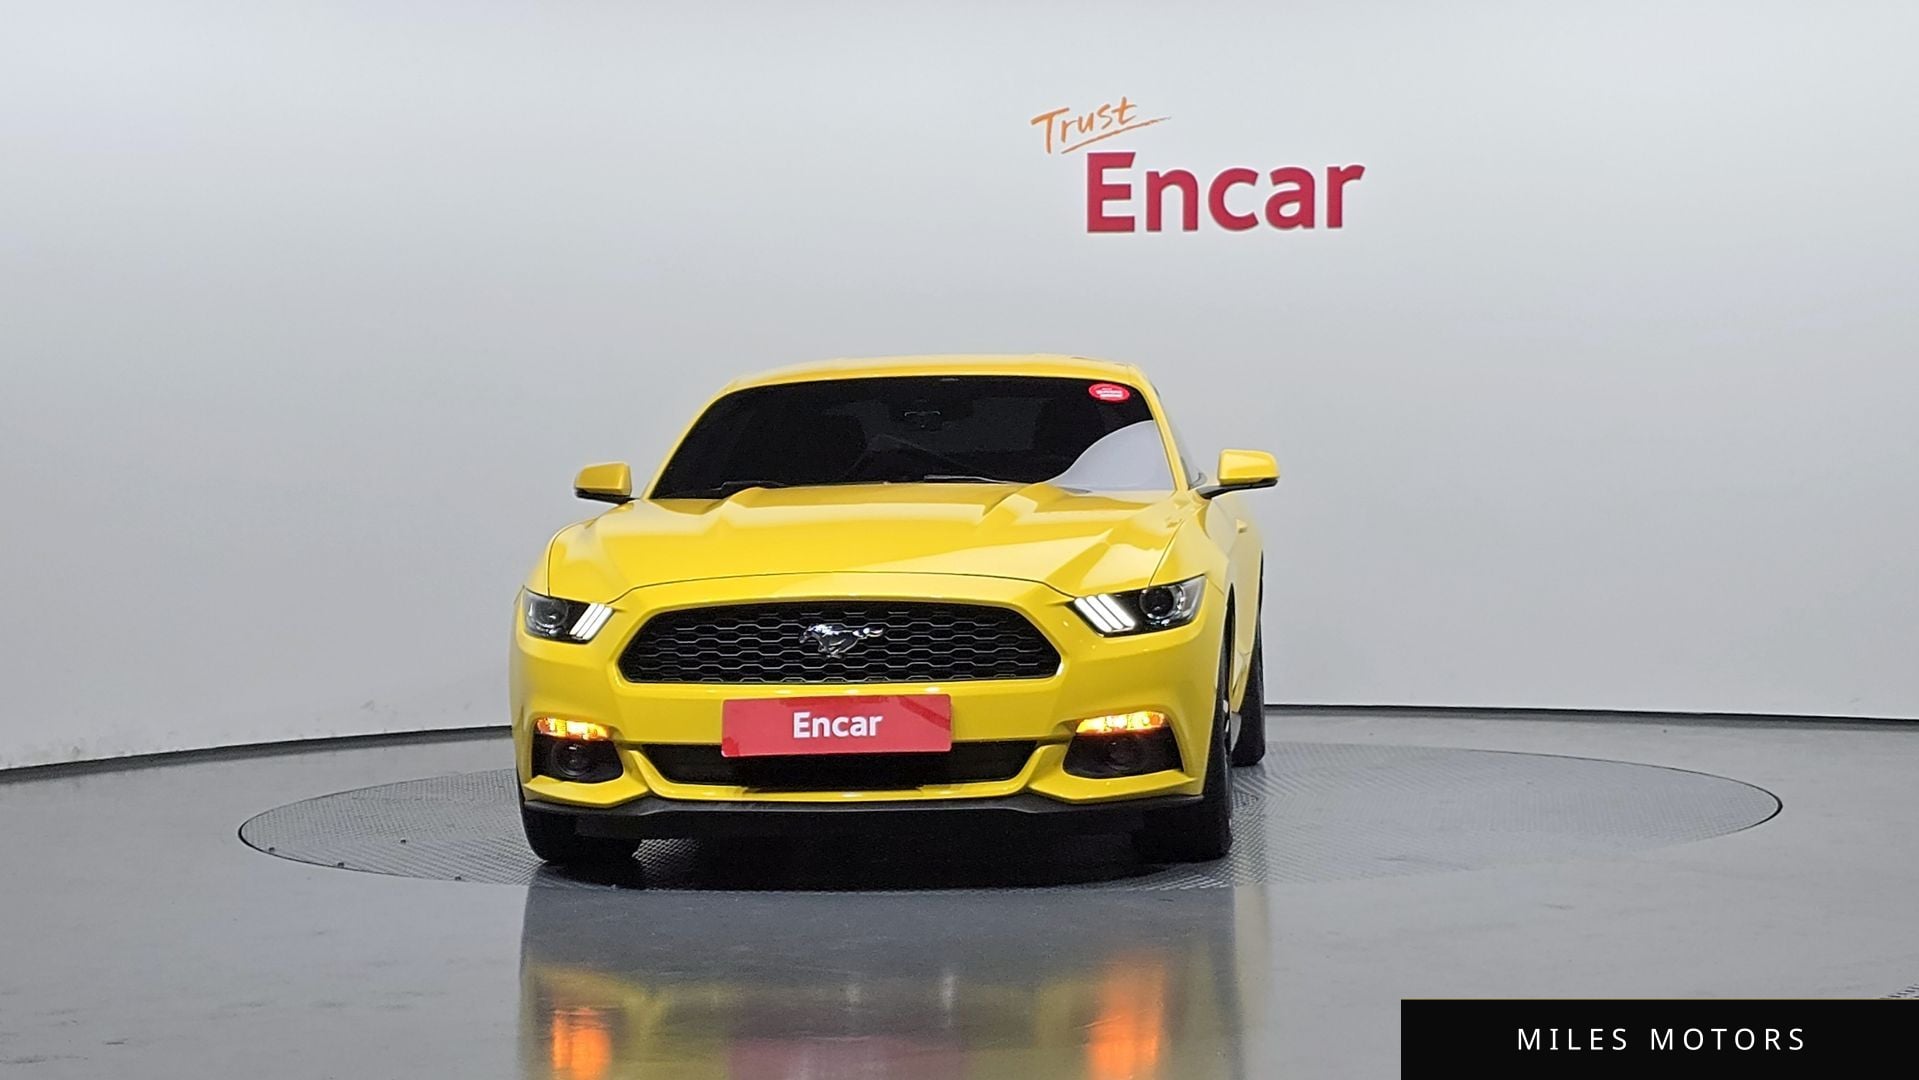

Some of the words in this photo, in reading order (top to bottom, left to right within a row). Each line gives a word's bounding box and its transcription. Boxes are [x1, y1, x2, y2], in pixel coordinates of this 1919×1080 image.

[1030, 96, 1138, 154] Trust
[1086, 151, 1366, 233] Encar
[793, 711, 883, 739] Encar
